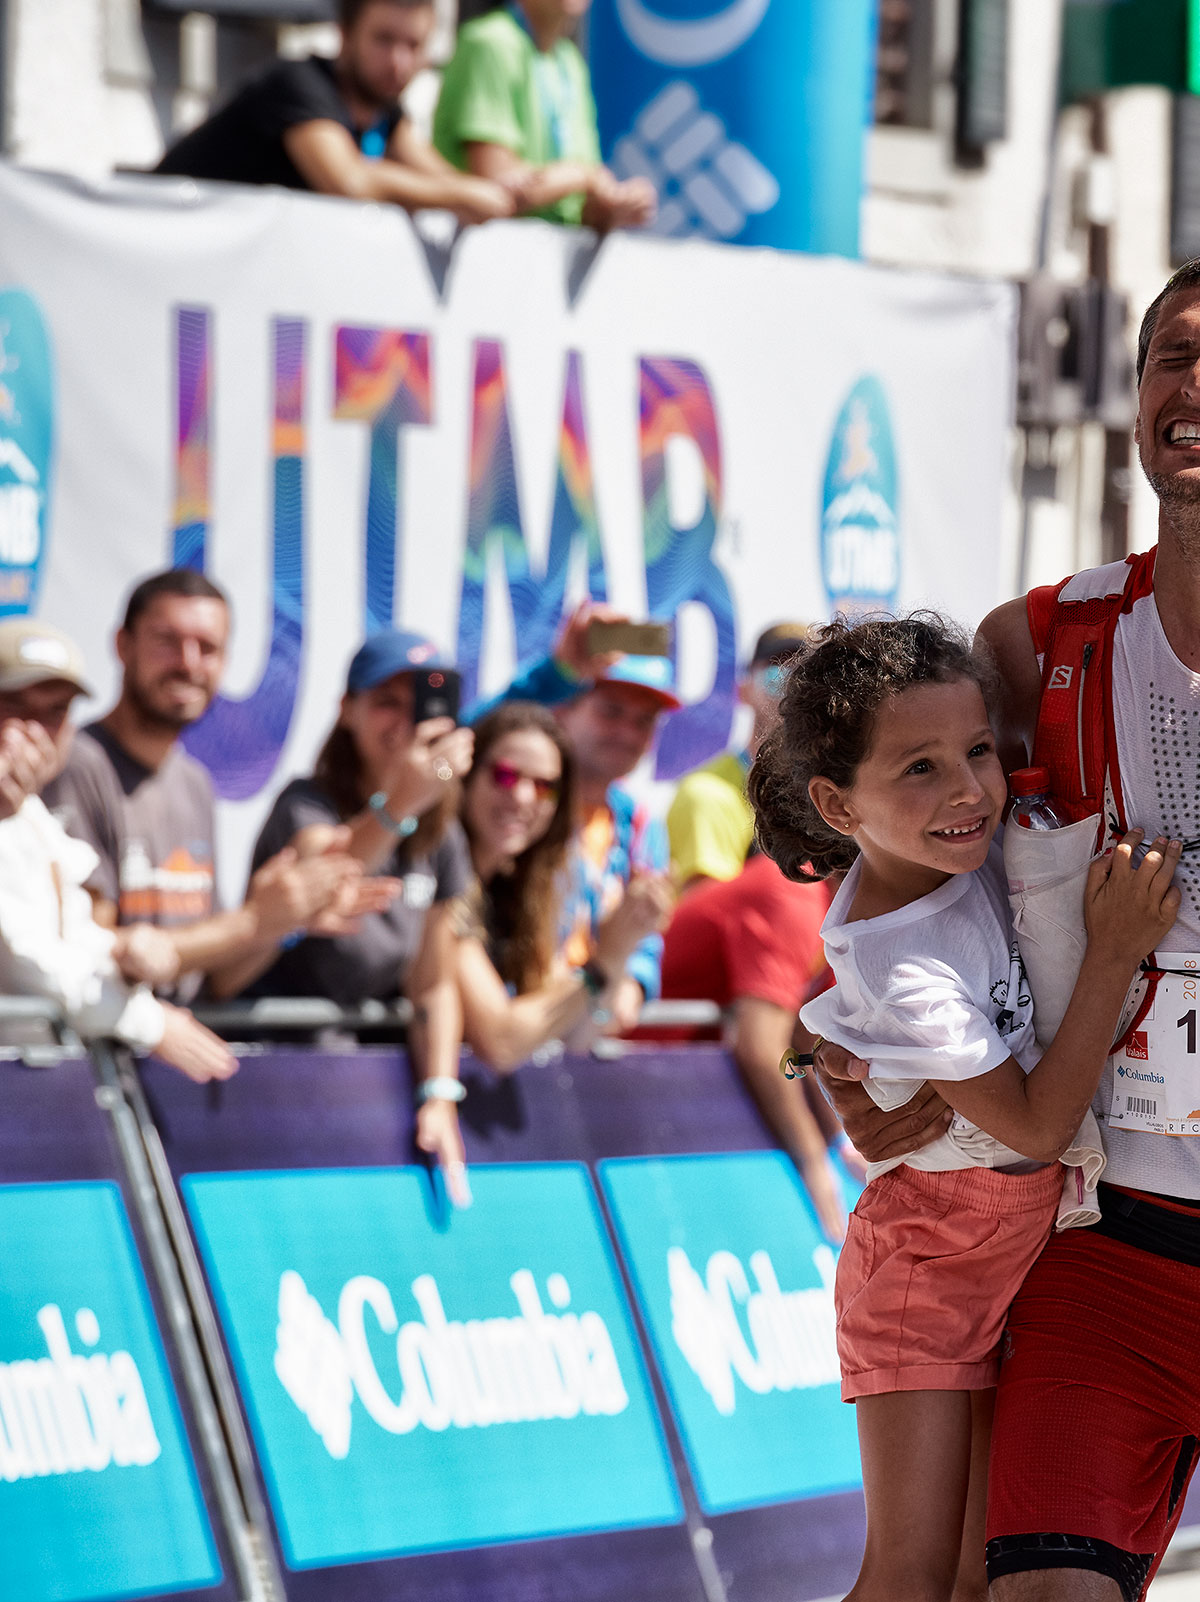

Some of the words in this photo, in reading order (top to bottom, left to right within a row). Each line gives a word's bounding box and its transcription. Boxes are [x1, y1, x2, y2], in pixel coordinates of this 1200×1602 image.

[172, 306, 738, 802] UTMB
[1183, 960, 1197, 1000] 208
[1126, 1046, 1147, 1059] Valais
[1125, 1066, 1165, 1084] Columbia
[338, 1267, 630, 1434] Columbia
